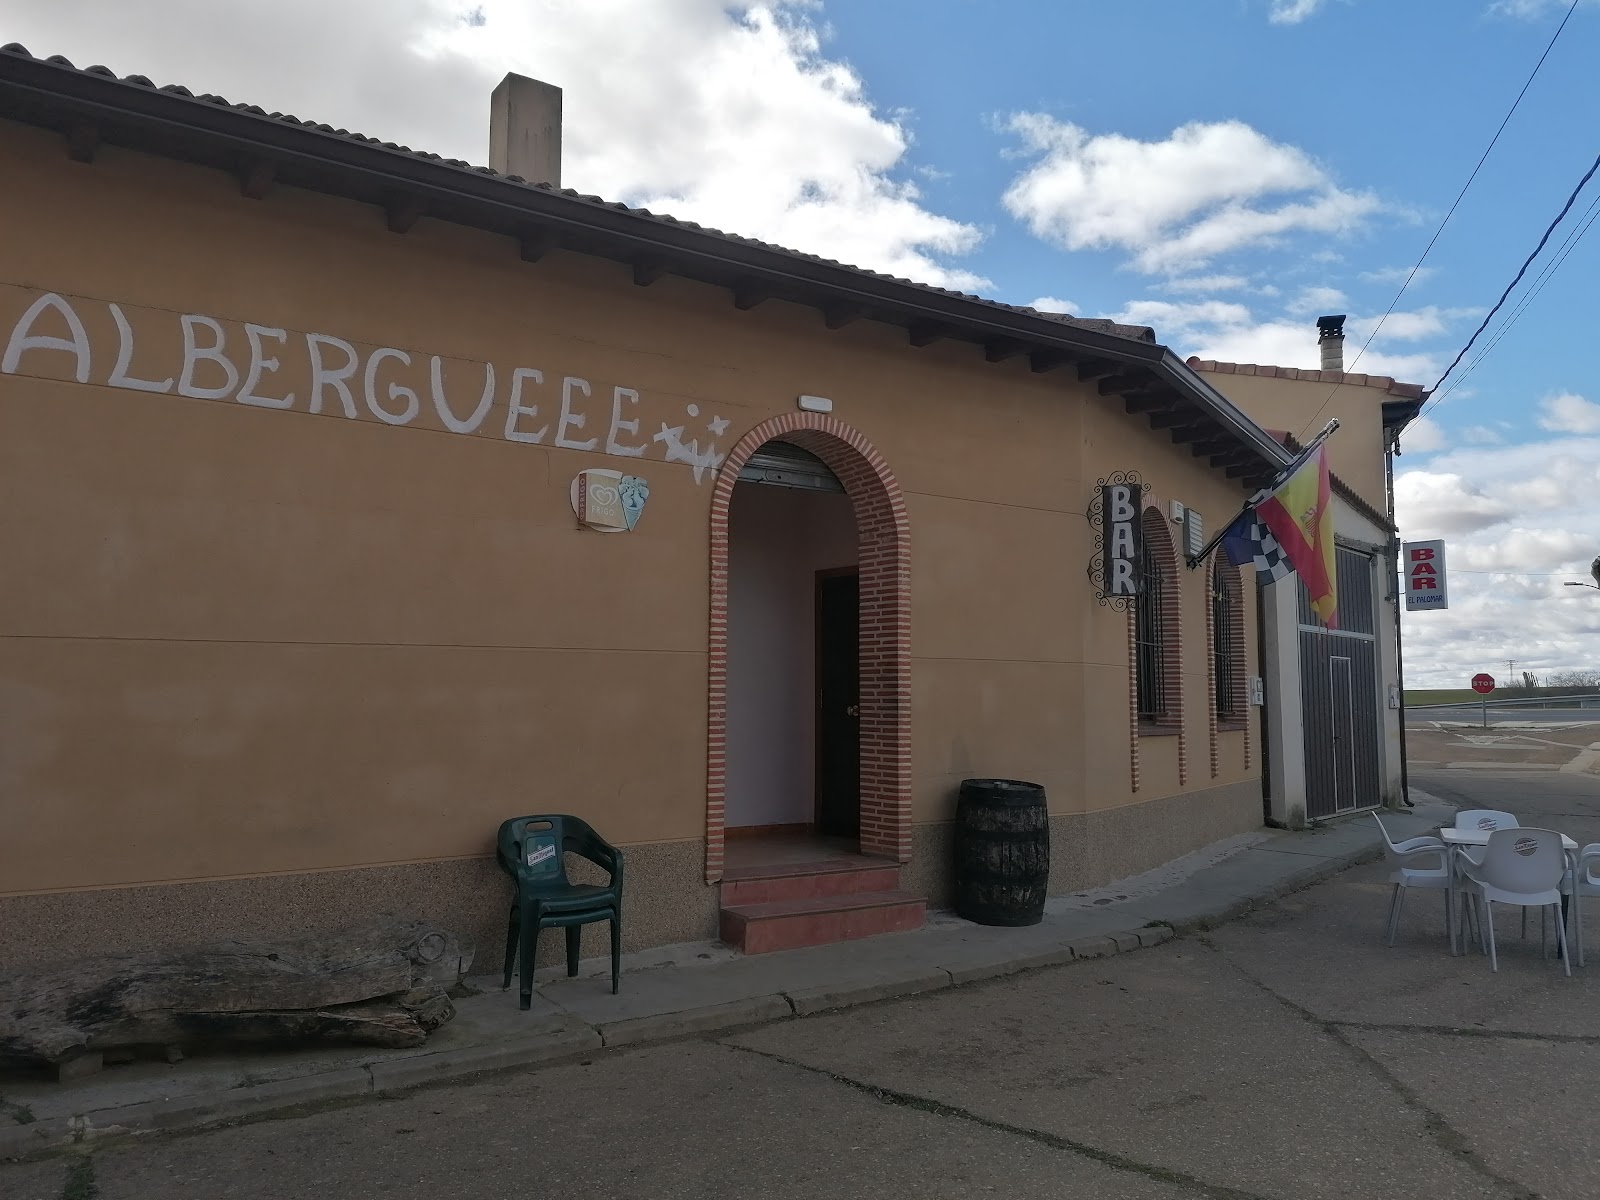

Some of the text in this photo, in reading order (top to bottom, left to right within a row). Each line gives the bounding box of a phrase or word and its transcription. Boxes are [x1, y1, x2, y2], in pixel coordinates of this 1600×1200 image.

[2, 292, 648, 456] ALBERGUEEE
[591, 505, 615, 517] FRIGO
[1111, 486, 1137, 594] BAR
[1411, 548, 1438, 590] BAR
[1408, 594, 1443, 604] EL PALOMAR
